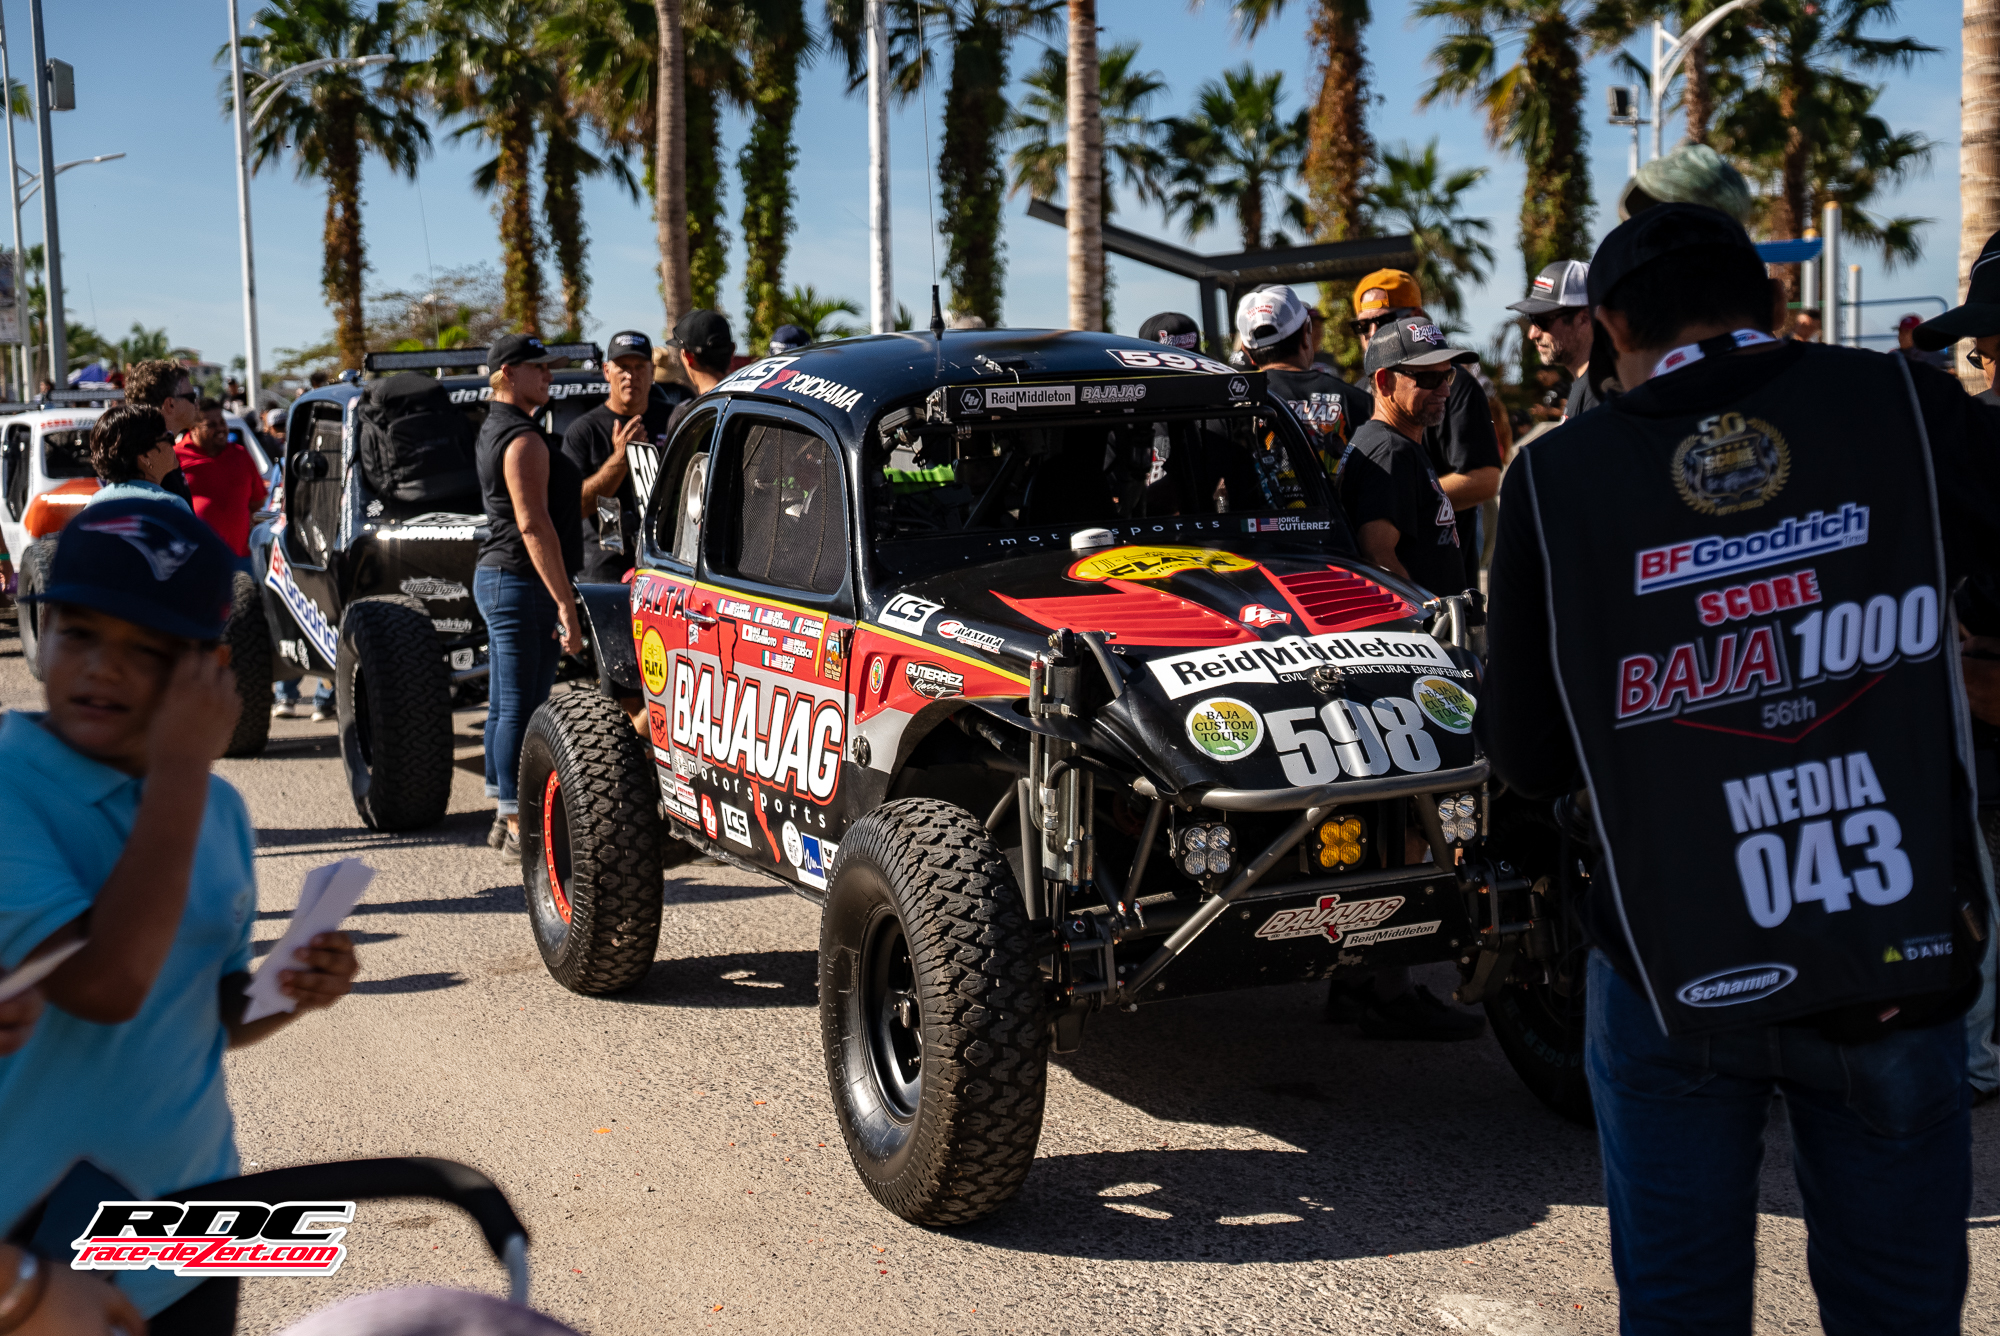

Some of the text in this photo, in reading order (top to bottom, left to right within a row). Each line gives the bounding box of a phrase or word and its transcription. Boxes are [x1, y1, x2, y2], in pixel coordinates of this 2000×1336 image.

[1120, 351, 1238, 373] 598
[782, 372, 864, 412] YOKOHAMA
[1082, 385, 1147, 400] BAJAJAG
[1697, 412, 1747, 446] 50
[1000, 519, 1220, 547] motsports
[1278, 516, 1300, 524] JORGE
[1640, 506, 1867, 581] BFGoodrich
[643, 582, 687, 621] ALTA
[885, 596, 936, 622] LCS
[1699, 569, 1822, 627] SCORE
[1616, 585, 1940, 720] BAJA 1000
[905, 663, 964, 687] GUTIERREZ
[1279, 671, 1308, 683] CIVIL
[1347, 664, 1411, 675] STRUCTURAL
[1411, 665, 1474, 679] ENGINEERING
[912, 678, 950, 698] Racing
[1424, 686, 1452, 698] BAJA
[1424, 693, 1468, 710] CUSTOM
[1206, 710, 1240, 720] BAJA
[1435, 703, 1471, 718] TOURS
[1761, 698, 1817, 729] 56th
[673, 659, 844, 800] BAJAJAG
[1194, 720, 1255, 731] CUSTOM
[1201, 731, 1249, 742] TOURS
[1263, 697, 1442, 787] 598
[688, 759, 827, 829] motorsports
[1722, 751, 1887, 834] MEDIA
[1735, 808, 1914, 929] 043
[1261, 898, 1403, 936] BAJAJAG
